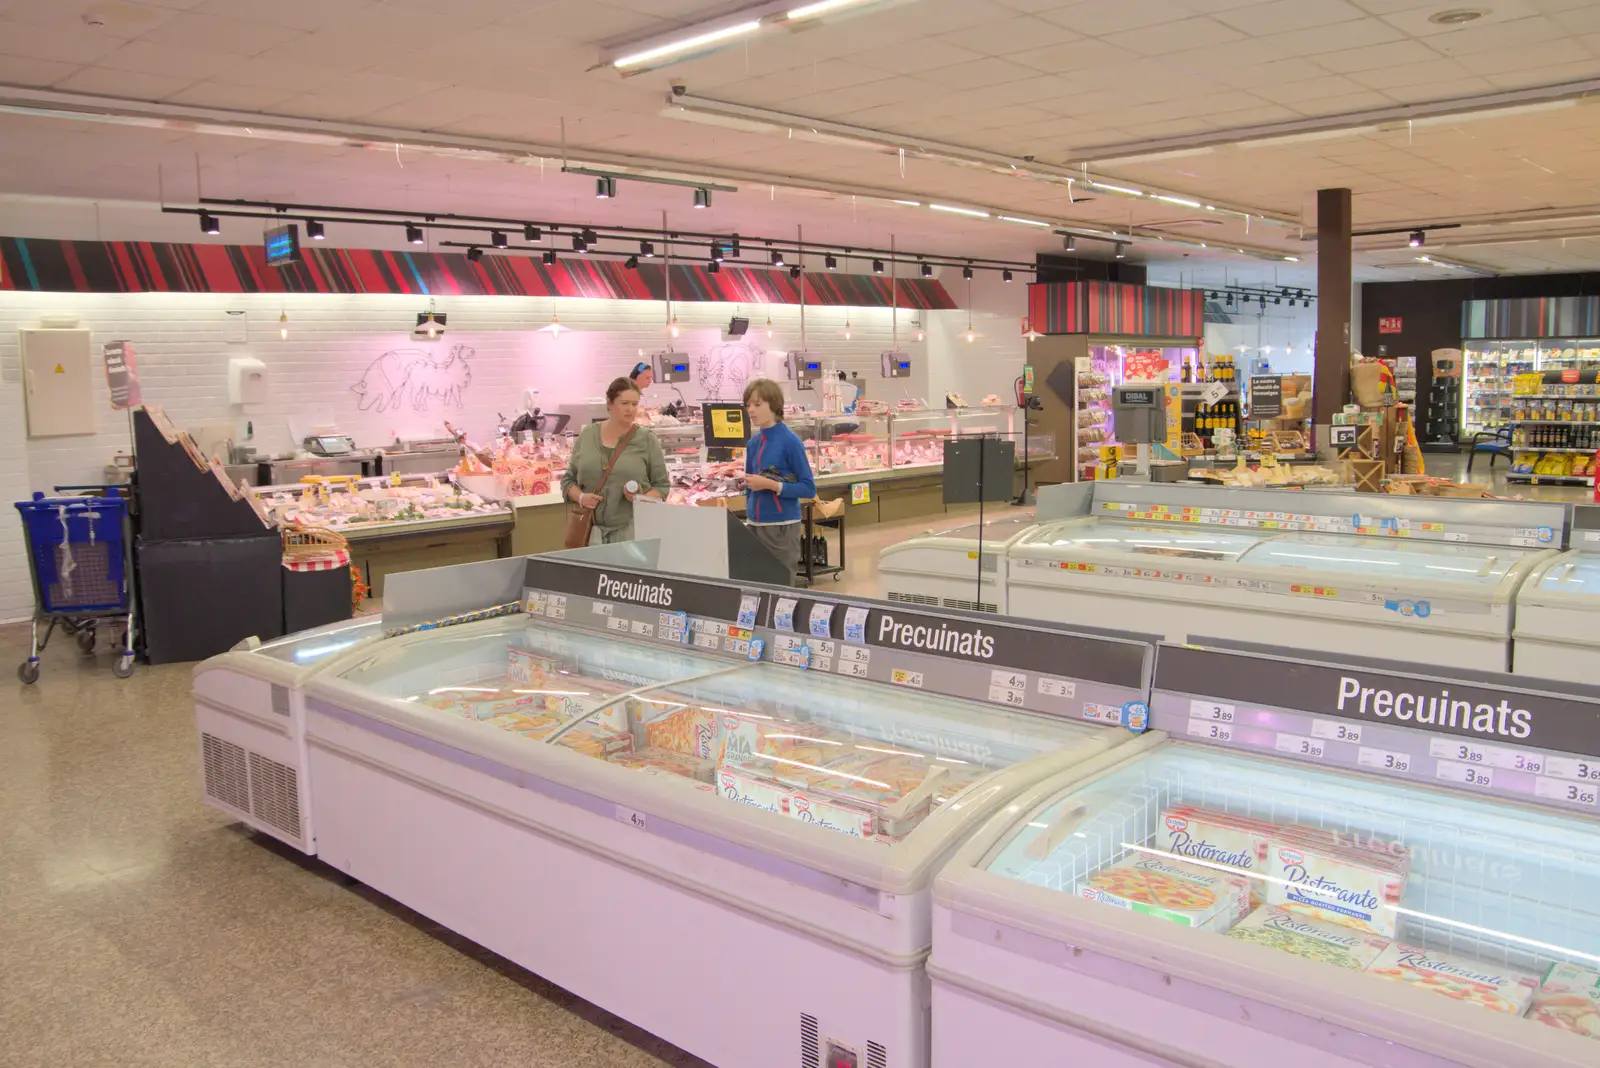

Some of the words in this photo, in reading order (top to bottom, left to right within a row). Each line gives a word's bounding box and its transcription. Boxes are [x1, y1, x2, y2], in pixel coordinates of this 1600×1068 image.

[1125, 392, 1148, 400] DIBAL
[597, 573, 673, 606] Precuinats
[879, 615, 995, 659] Precuinats
[1337, 676, 1533, 739] Precuinats
[727, 736, 752, 757] MIA
[1169, 830, 1253, 869] Ristorante
[1292, 896, 1309, 904] PIZZA
[1310, 900, 1336, 910] QUATTRO
[1336, 907, 1366, 919] FORMAGGI
[1263, 915, 1360, 947] Ristorante
[1397, 951, 1509, 987] Ristorante
